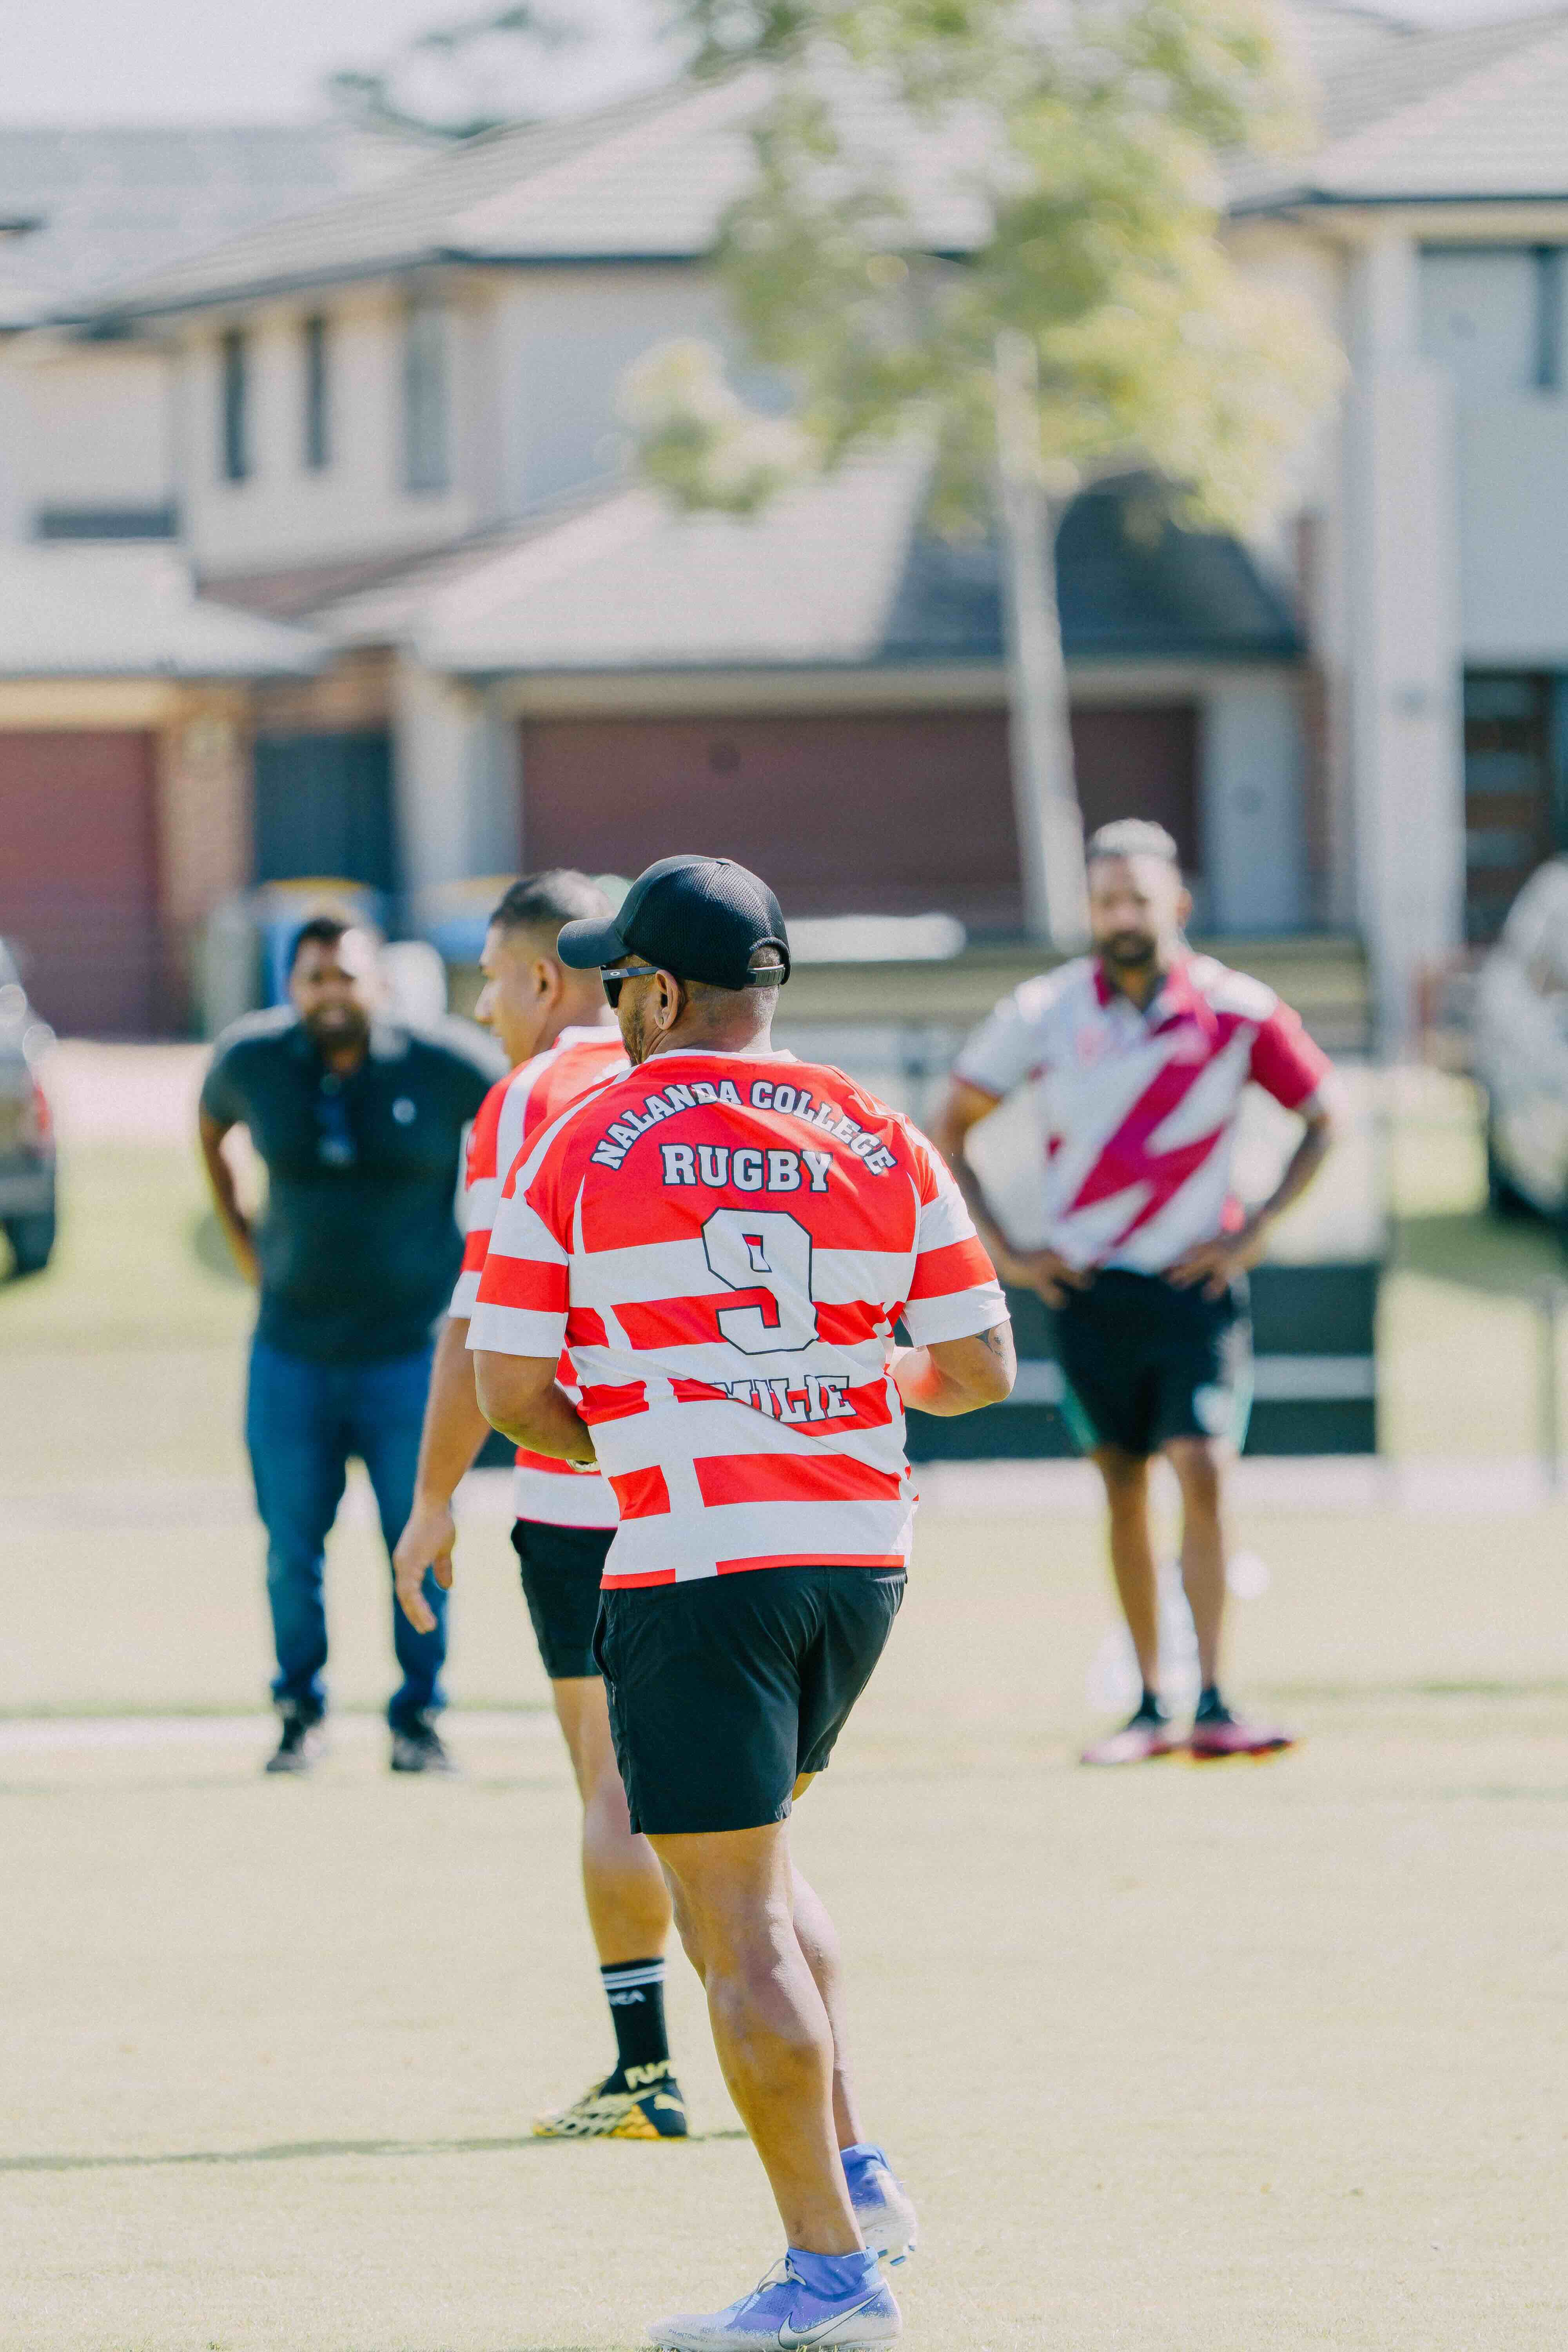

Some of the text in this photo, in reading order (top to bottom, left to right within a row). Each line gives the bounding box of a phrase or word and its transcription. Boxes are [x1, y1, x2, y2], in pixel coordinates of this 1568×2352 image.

[591, 1080, 897, 1175] NALANDA COLLEGE
[660, 1143, 832, 1192] RUGBY
[701, 1208, 820, 1355] 9
